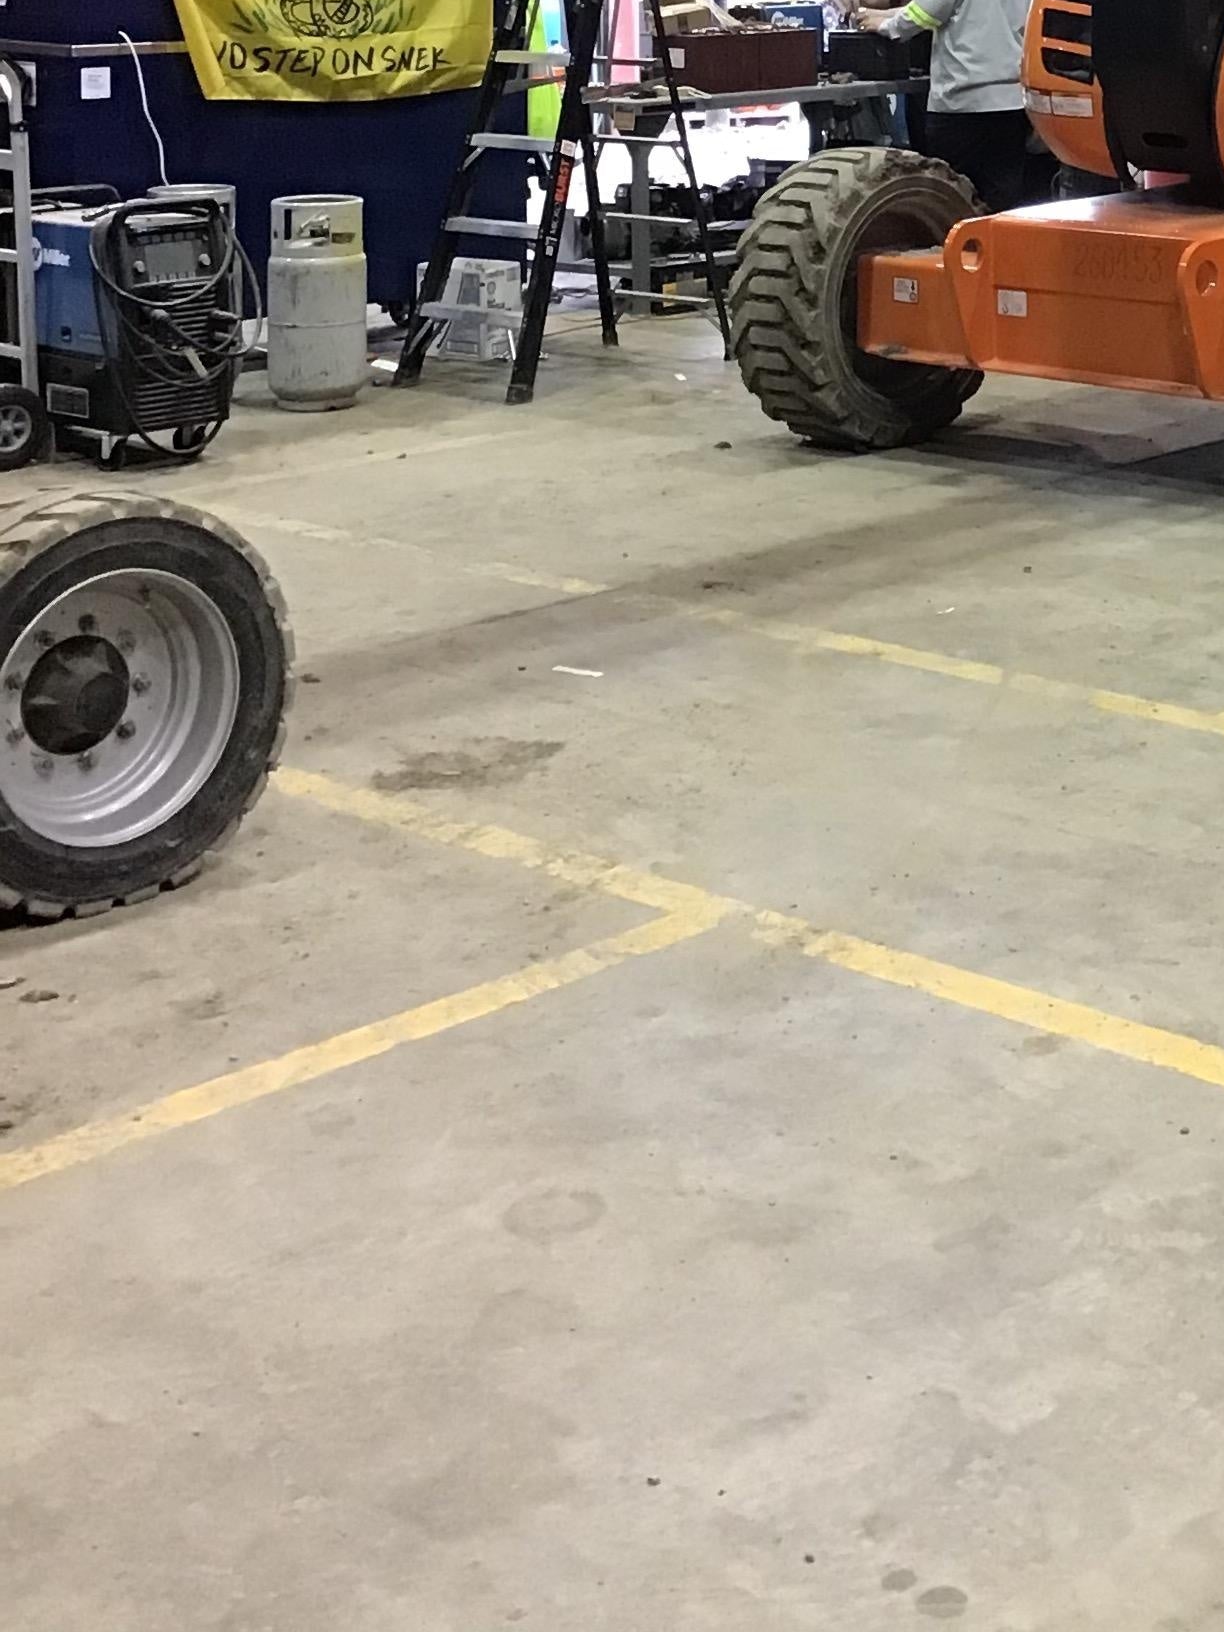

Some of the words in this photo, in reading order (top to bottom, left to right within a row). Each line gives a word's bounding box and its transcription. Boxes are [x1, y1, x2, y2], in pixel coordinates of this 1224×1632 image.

[252, 45, 325, 77] STEP
[331, 46, 375, 76] ON
[380, 45, 453, 73] SNEK
